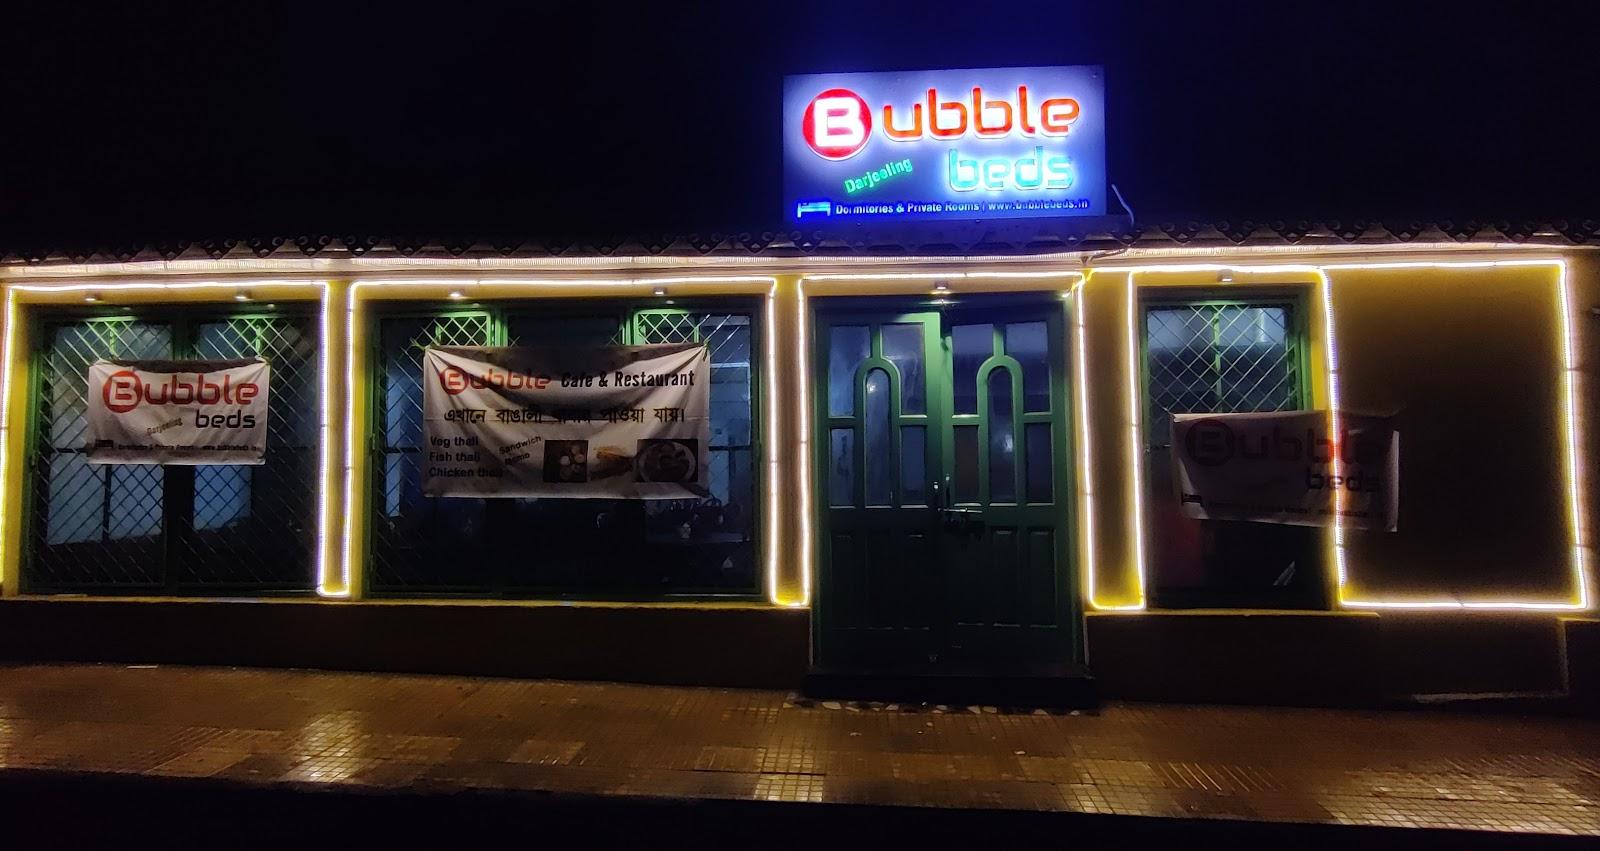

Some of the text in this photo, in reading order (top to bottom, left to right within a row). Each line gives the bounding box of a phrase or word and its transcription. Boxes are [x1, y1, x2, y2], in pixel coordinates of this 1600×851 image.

[802, 85, 1080, 161] Bubble
[844, 158, 913, 194] Darjeeling
[949, 146, 1075, 191] beds
[836, 203, 894, 215] Dormitories
[896, 203, 905, 214] &
[907, 202, 942, 213] Private
[945, 201, 980, 212] Rooms
[439, 364, 695, 395] Bubble Cafe & Restaurant
[103, 370, 259, 413] Bubble
[195, 409, 256, 429] beds
[444, 408, 487, 424] এখানে
[430, 436, 479, 449] Veg thali
[499, 434, 542, 455] Sandwich
[429, 451, 452, 462] Fish
[429, 467, 474, 478] Chicken
